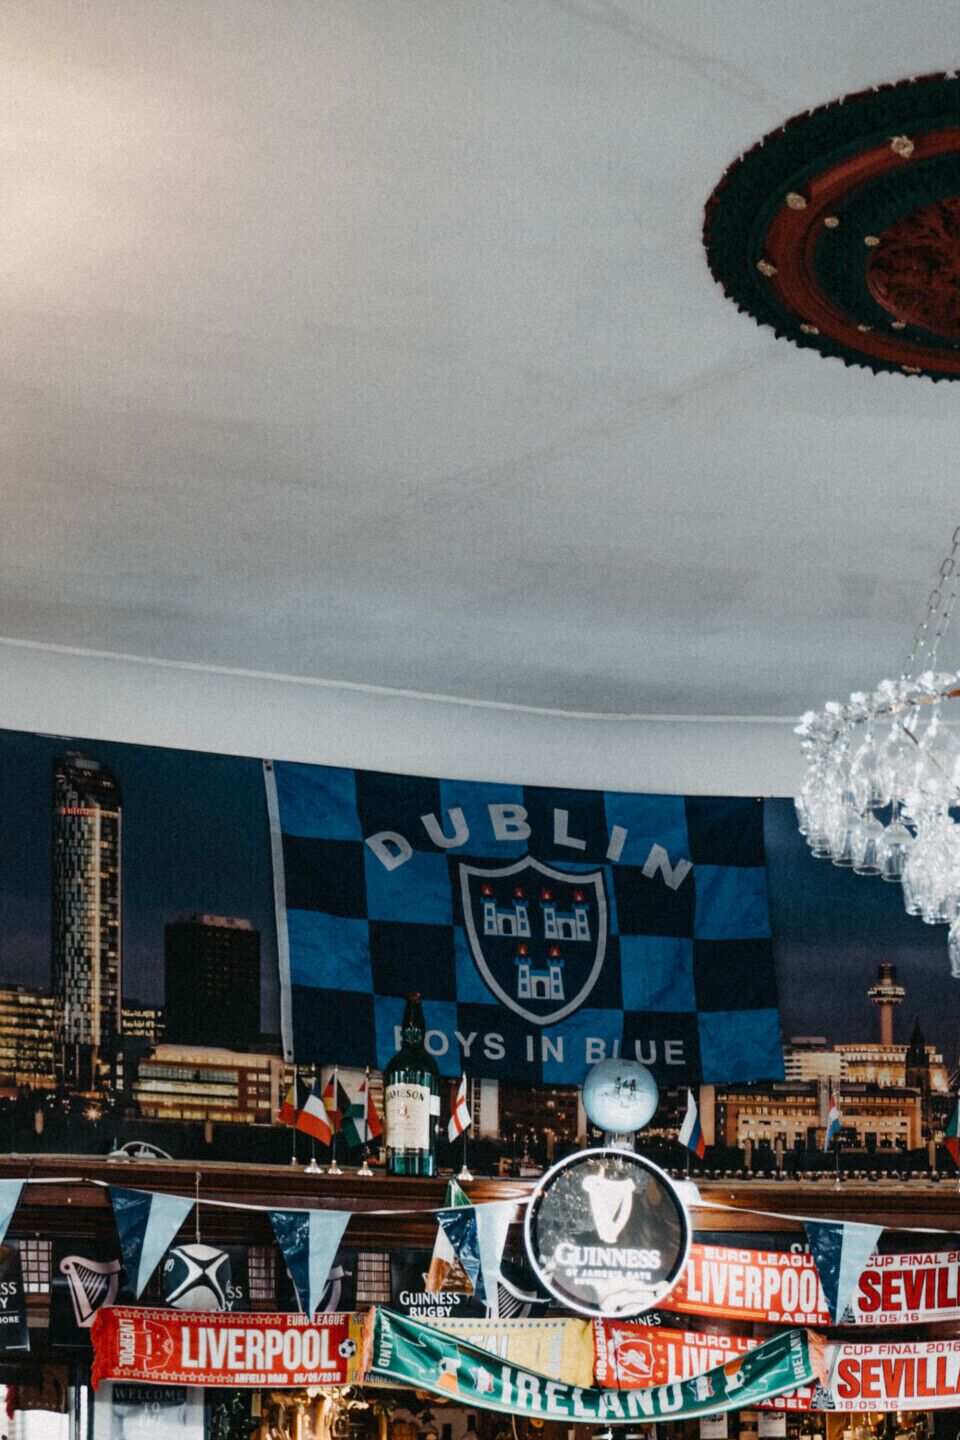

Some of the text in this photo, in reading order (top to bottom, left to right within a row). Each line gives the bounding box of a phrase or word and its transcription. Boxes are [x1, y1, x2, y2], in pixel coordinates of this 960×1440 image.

[365, 804, 693, 890] DUBLIN
[526, 1035, 564, 1063] IN
[554, 1242, 662, 1269] GUINNESS
[703, 1246, 815, 1268] EURO LEAGU
[900, 1254, 942, 1266] FINAL
[399, 1291, 461, 1306] GUINNESS
[409, 1306, 453, 1318] RUGBY
[767, 1311, 828, 1324] BASEL
[858, 1312, 920, 1323] 18/05/16
[311, 1314, 346, 1326] LEAGUE
[683, 1332, 735, 1348] EURO
[181, 1326, 337, 1371] LIVERPOOL
[843, 1345, 873, 1355] CUP
[878, 1343, 920, 1355] FINAL
[234, 1374, 267, 1384] ANFIELD
[268, 1373, 289, 1384] ROAD
[114, 1388, 184, 1401] WELCOME
[501, 1364, 684, 1419] IRELAND
[143, 1401, 161, 1413] TO
